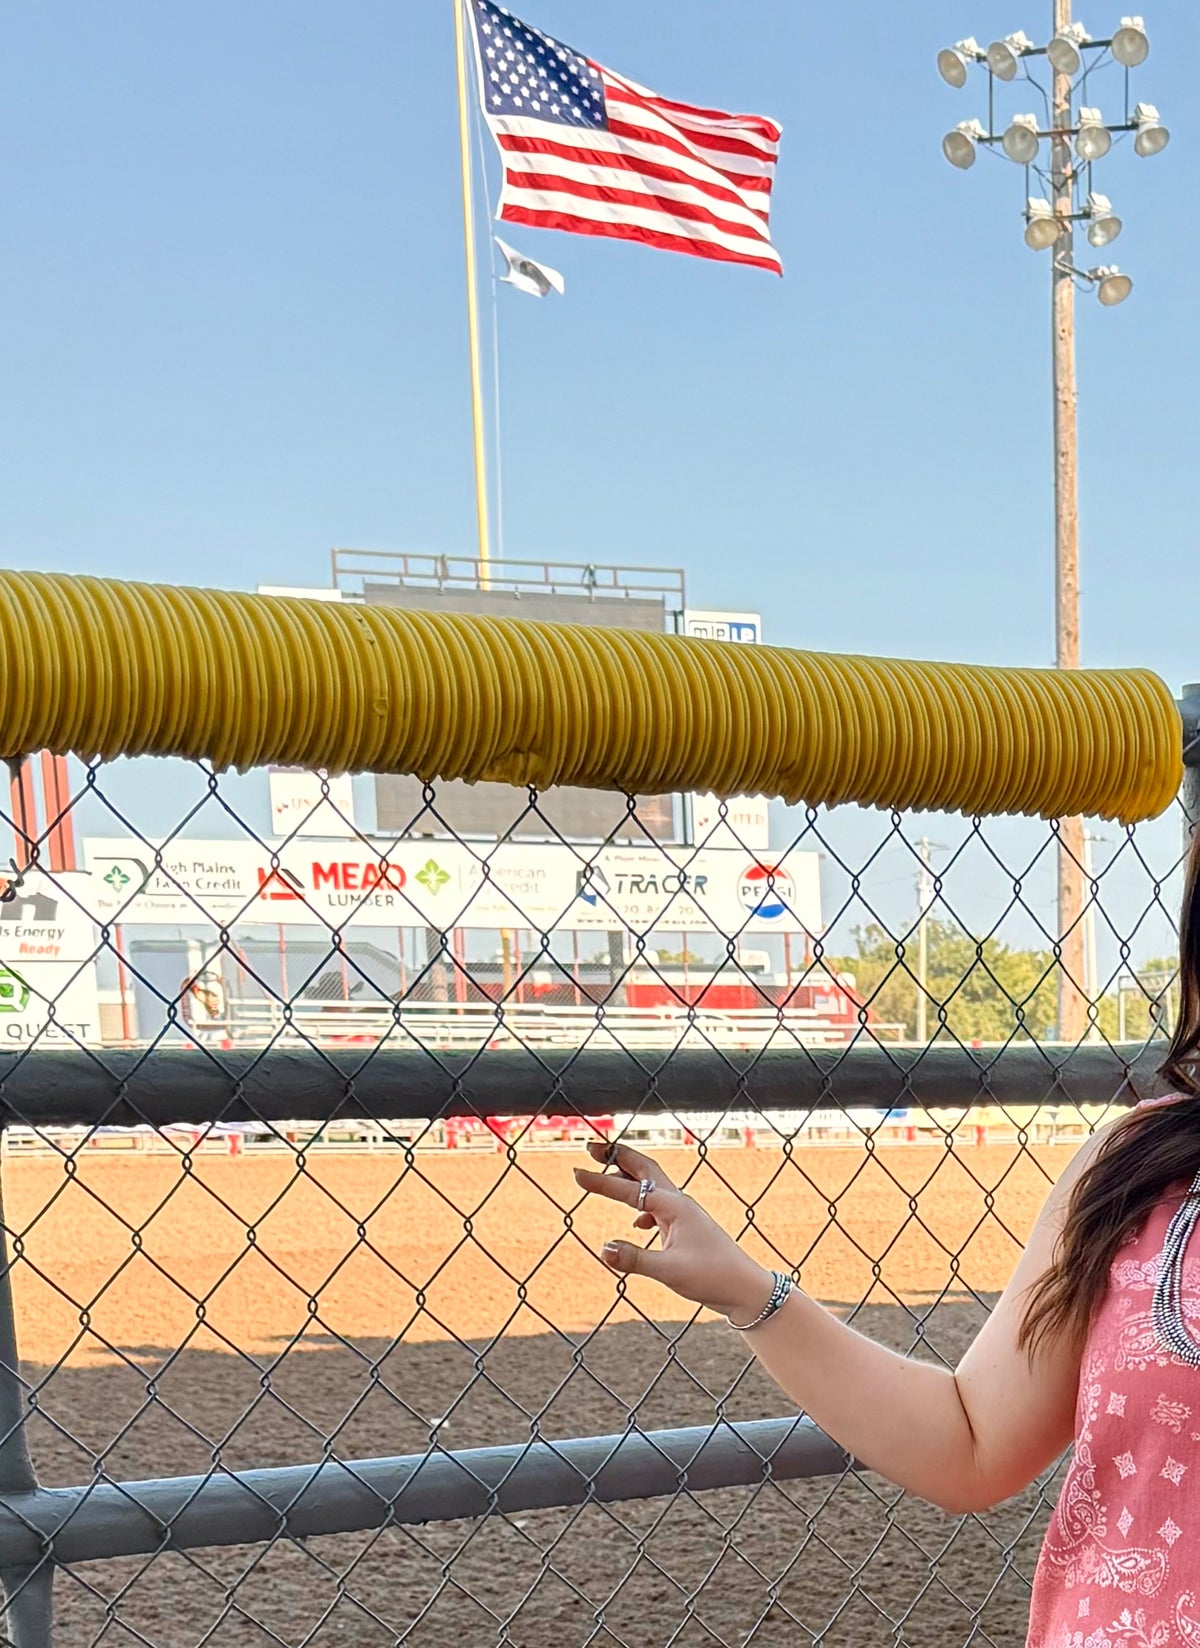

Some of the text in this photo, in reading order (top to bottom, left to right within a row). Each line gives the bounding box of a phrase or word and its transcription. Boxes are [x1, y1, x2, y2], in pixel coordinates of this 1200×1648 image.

[312, 862, 407, 891] MEAD
[469, 864, 546, 879] Aerican
[195, 877, 241, 890] Credit
[742, 886, 792, 898] PESI
[14, 925, 64, 939] Energy
[19, 942, 61, 958] Ready
